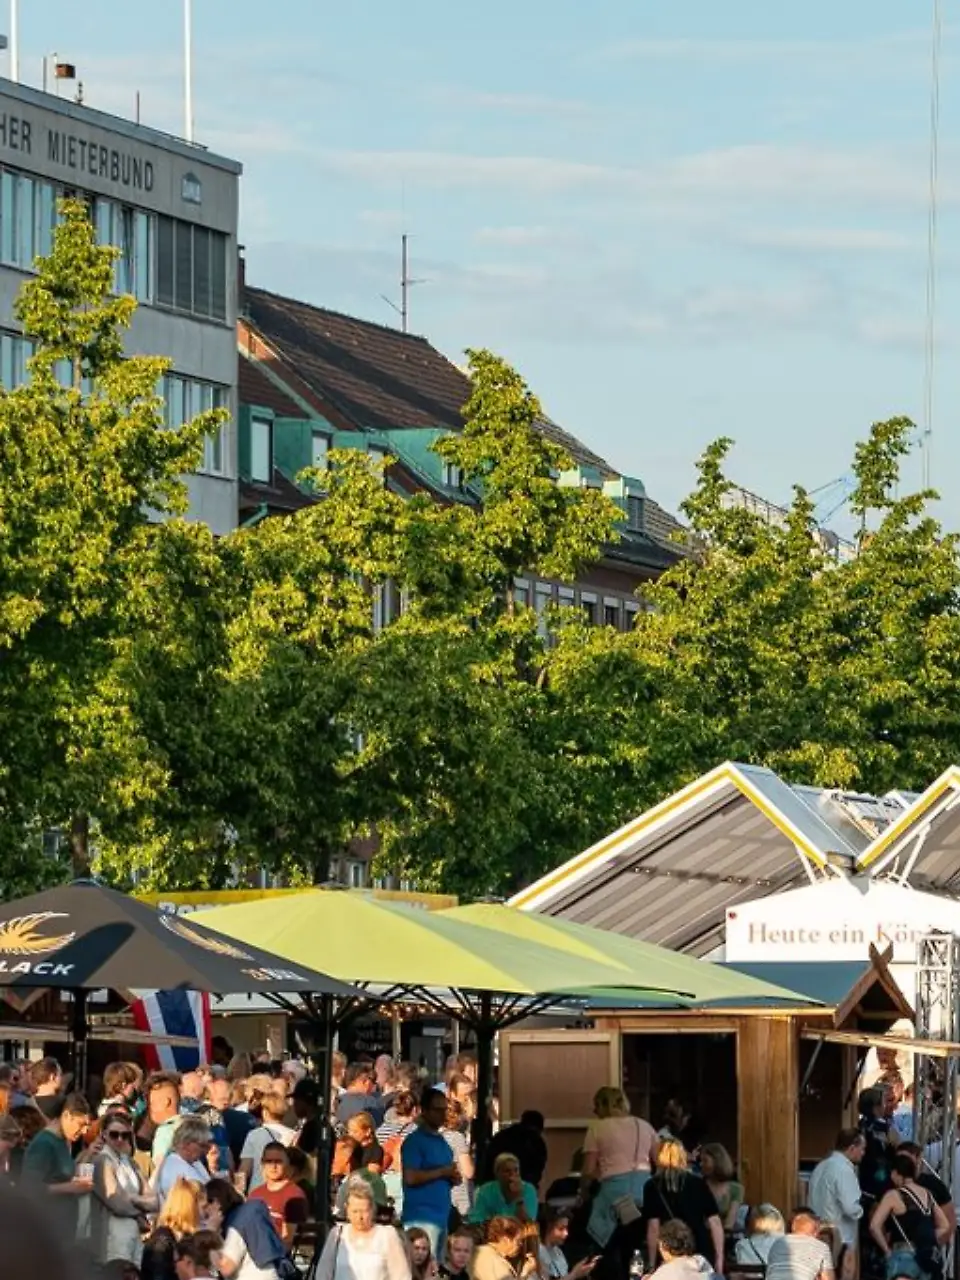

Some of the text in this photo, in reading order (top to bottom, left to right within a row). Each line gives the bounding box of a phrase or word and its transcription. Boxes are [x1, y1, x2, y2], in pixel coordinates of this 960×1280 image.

[48, 129, 154, 192] MIETERBUND
[748, 921, 823, 944] Heute
[829, 923, 864, 944] ein
